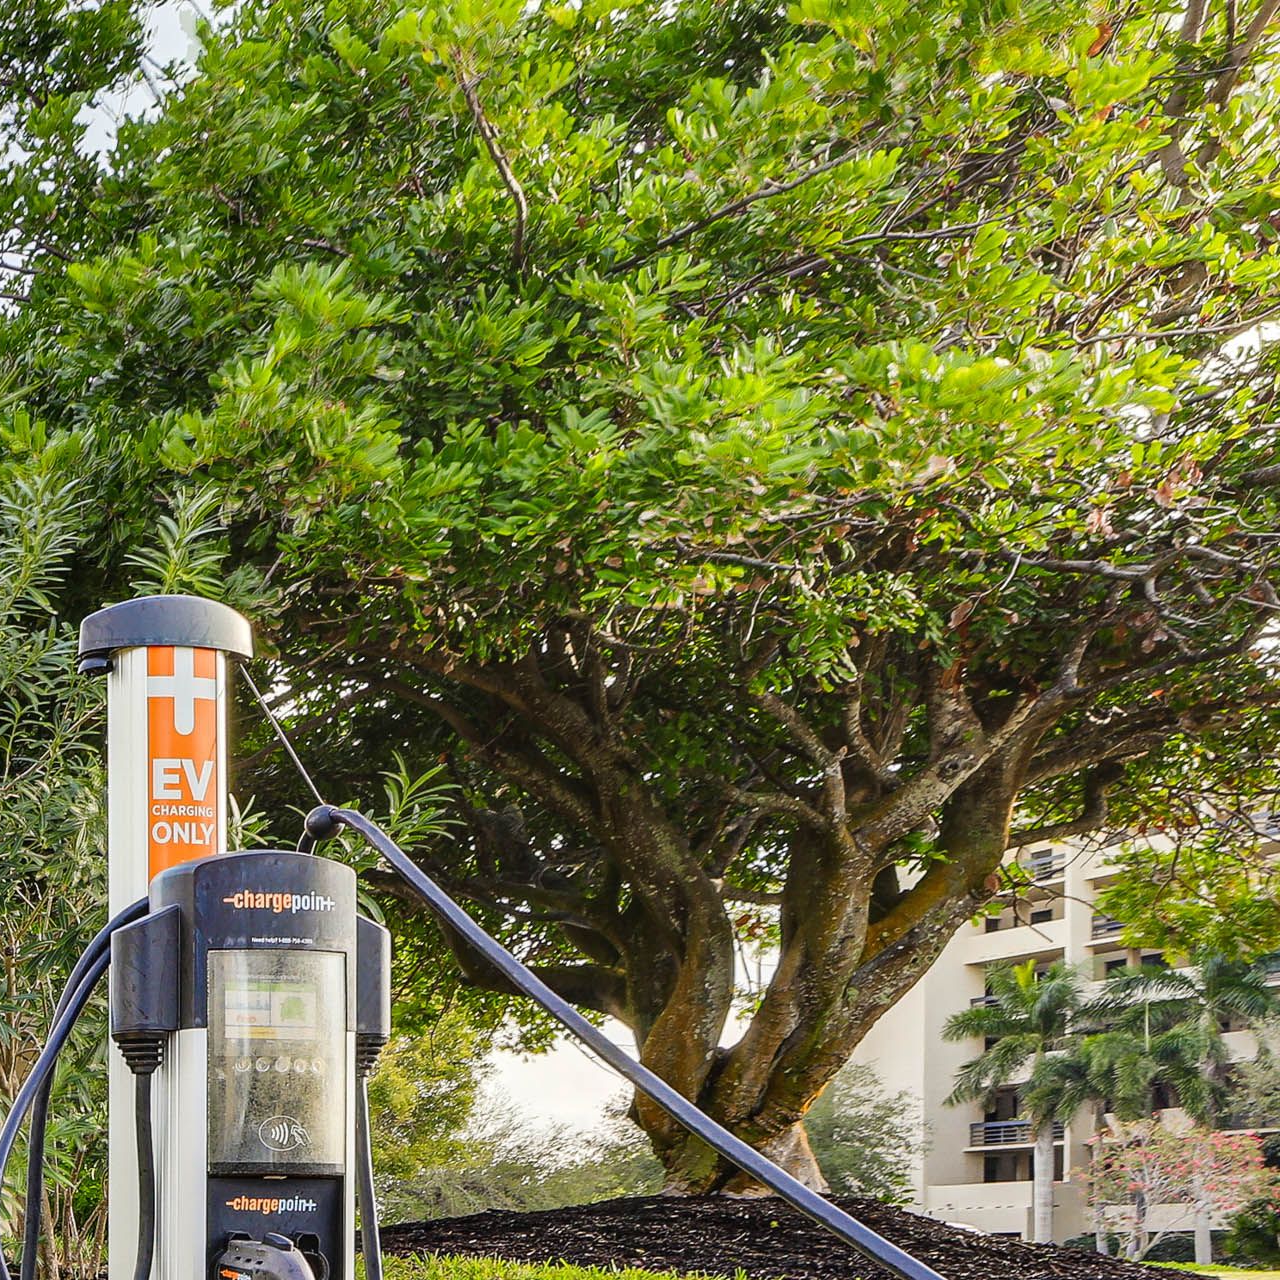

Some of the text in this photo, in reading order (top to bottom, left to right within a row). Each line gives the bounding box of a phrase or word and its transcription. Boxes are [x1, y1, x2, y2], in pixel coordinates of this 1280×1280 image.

[152, 758, 214, 801] EV
[152, 804, 213, 817] CHARGING
[151, 821, 215, 845] ONLY
